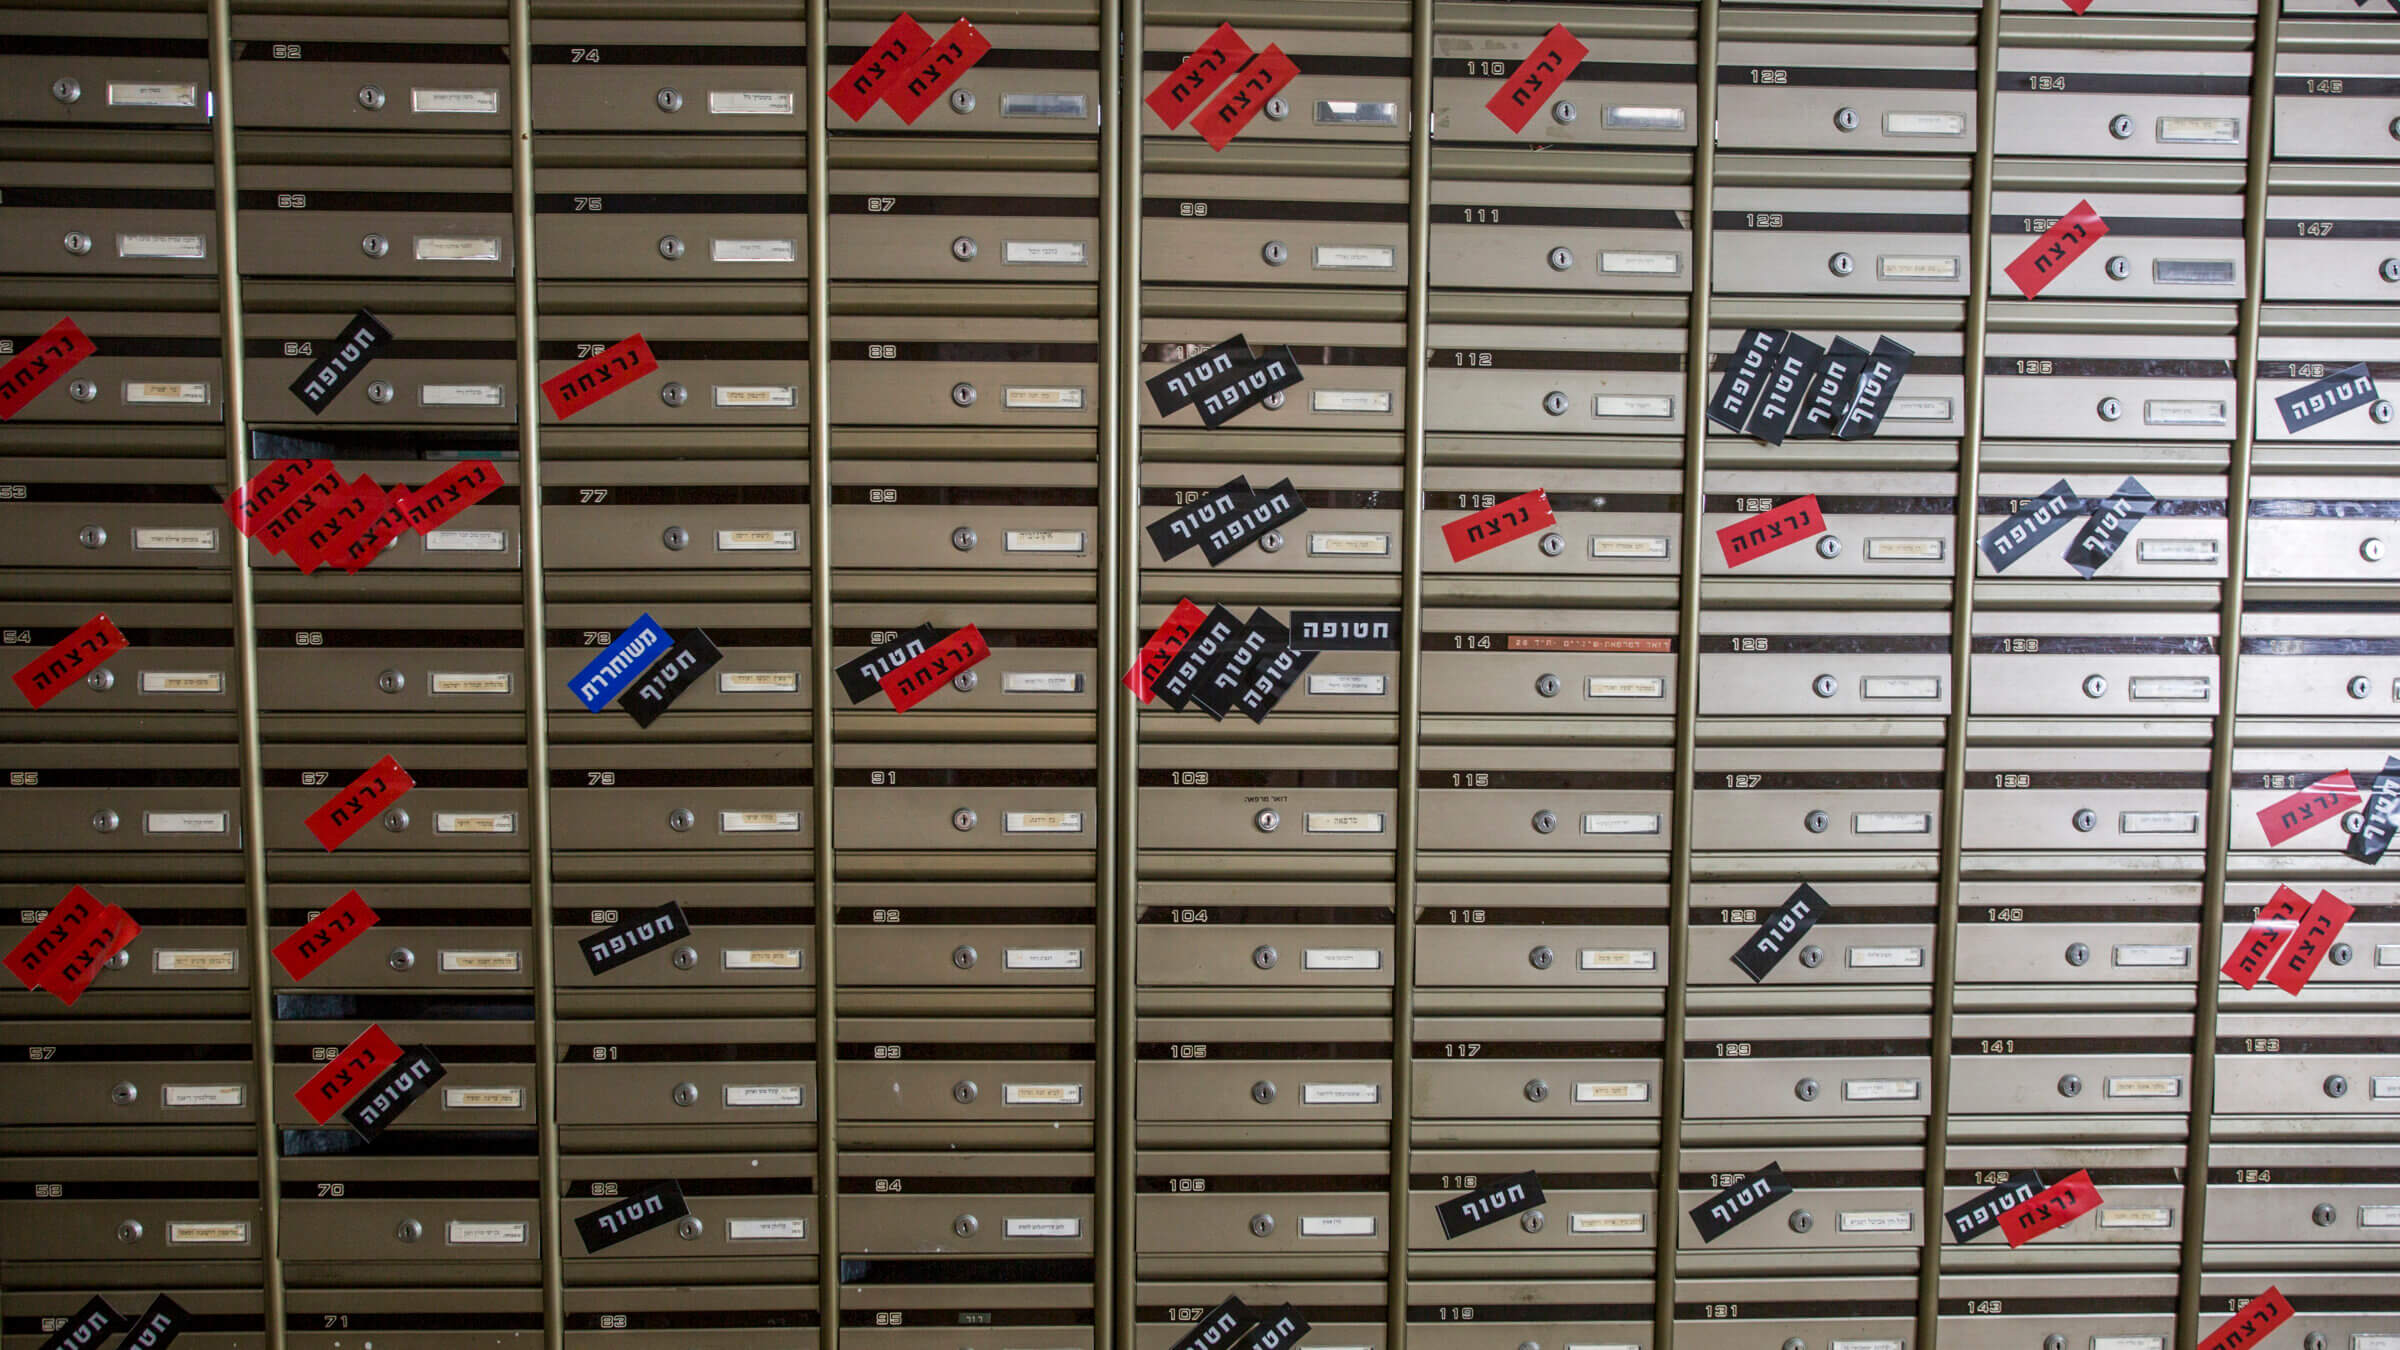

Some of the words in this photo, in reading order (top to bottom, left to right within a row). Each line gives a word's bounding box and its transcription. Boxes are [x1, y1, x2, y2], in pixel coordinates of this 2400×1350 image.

[272, 44, 302, 59] 62
[570, 48, 600, 63] 74
[853, 39, 908, 95] נרצח
[907, 42, 963, 97] נרצח
[1467, 60, 1505, 76] 110
[1171, 48, 1226, 103] נרצח
[1511, 50, 1563, 107] נרצח
[1750, 69, 1788, 84] 122
[2029, 75, 2066, 91] 134
[2306, 79, 2343, 93] 146
[1218, 68, 1273, 124] נרצח
[277, 193, 306, 208] 63
[573, 196, 602, 211] 75
[867, 197, 896, 212] 87
[1180, 202, 1208, 217] 99
[1463, 208, 1499, 223] 111
[1746, 213, 1783, 228] 123
[2297, 222, 2334, 236] 147
[2034, 223, 2087, 273] נרצח
[0, 339, 14, 354] 2
[284, 342, 313, 356] 64
[868, 344, 897, 359] 88
[304, 327, 375, 401] חטופה
[1455, 352, 1493, 367] 112
[2016, 360, 2053, 374] 136
[0, 335, 75, 401] נרצחה
[559, 349, 640, 402] נרצחה
[1167, 353, 1233, 397] חטוף
[1723, 331, 1774, 414] חטופה
[2288, 363, 2325, 378] 148
[1203, 361, 1286, 415] חטופה
[1762, 356, 1803, 419] חטוף
[1807, 361, 1847, 424] חטוף
[1850, 361, 1892, 424] חטוף
[2291, 375, 2372, 420] חטופה
[0, 485, 27, 499] 53
[239, 458, 313, 519] נרצחה
[408, 466, 486, 524] נרצחה
[869, 488, 897, 503] 89
[579, 489, 608, 504] 77
[1176, 490, 1209, 505] 10
[1459, 495, 1495, 508] 113
[266, 473, 340, 539] נרצחה
[1737, 498, 1773, 511] 125
[308, 497, 366, 550] נרצח
[1170, 494, 1235, 538] חטוף
[1209, 493, 1291, 550] חטופה
[1466, 506, 1529, 544] נרצח
[1730, 510, 1811, 553] נרצחה
[1994, 495, 2068, 555] חטופה
[2082, 497, 2131, 552] חטוף
[347, 506, 405, 561] נרצח
[2, 629, 32, 644] 54
[1303, 622, 1389, 639] חטופה
[295, 631, 323, 646] 66
[583, 631, 612, 646] 78
[1454, 635, 1491, 649] 114
[1732, 637, 1769, 651] 126
[2003, 638, 2039, 653] 138
[860, 638, 926, 682] חטוף
[1141, 624, 1190, 682] נרצח
[1166, 621, 1231, 696] חטופה
[1214, 631, 1266, 689] חטוף
[31, 631, 110, 691] נרצחה
[580, 627, 657, 702] משוחררת
[897, 641, 974, 696] נרצחה
[639, 649, 697, 701] חטוף
[9, 771, 39, 786] 55
[301, 771, 329, 786] 67
[587, 771, 615, 786] 79
[871, 770, 896, 785] 91
[1171, 771, 1209, 785] 103
[1452, 773, 1489, 787] 115
[1725, 774, 1762, 788] 127
[1995, 774, 2031, 788] 139
[2262, 774, 2296, 789] 151
[329, 777, 387, 827] נרצח
[2281, 792, 2339, 830] נרצח
[590, 909, 618, 924] 80
[872, 909, 900, 923] 92
[1171, 909, 1208, 923] 104
[1449, 909, 1486, 924] 116
[1720, 909, 1757, 923] 128
[1988, 908, 2024, 922] 140
[1757, 900, 1811, 953] חטוף
[20, 903, 89, 971] נרצחה
[297, 911, 356, 959] נרצח
[591, 914, 674, 961] חטופה
[2288, 914, 2332, 972] נרצח
[61, 927, 115, 982] נרצח
[874, 1045, 901, 1059] 93
[1170, 1044, 1207, 1059] 105
[1444, 1043, 1481, 1057] 117
[1715, 1043, 1752, 1057] 129
[1981, 1039, 2014, 1054] 141
[2245, 1038, 2280, 1052] 153
[28, 1046, 57, 1060] 57
[592, 1046, 617, 1061] 81
[320, 1048, 376, 1100] נרצח
[359, 1058, 431, 1125] חטופה
[1441, 1175, 1477, 1189] 118
[2236, 1169, 2271, 1183] 154
[35, 1183, 63, 1198] 58
[317, 1183, 345, 1197] 70
[591, 1182, 619, 1196] 82
[875, 1178, 902, 1193] 94
[1169, 1178, 1206, 1193] 106
[1461, 1183, 1525, 1221] חטוף
[1711, 1178, 1772, 1222] חטוף
[598, 1194, 663, 1233] חטוף
[1956, 1183, 2034, 1233] חטופה
[2018, 1189, 2076, 1230] נרצח
[1168, 1307, 1204, 1321] 107
[1439, 1307, 1474, 1321] 119
[1705, 1304, 1738, 1318] 131
[1967, 1300, 2002, 1314] 143
[323, 1314, 348, 1329] 71
[600, 1314, 627, 1329] 83
[875, 1311, 903, 1326] 95
[56, 1312, 109, 1350] חטו
[1187, 1313, 1237, 1350] חטו
